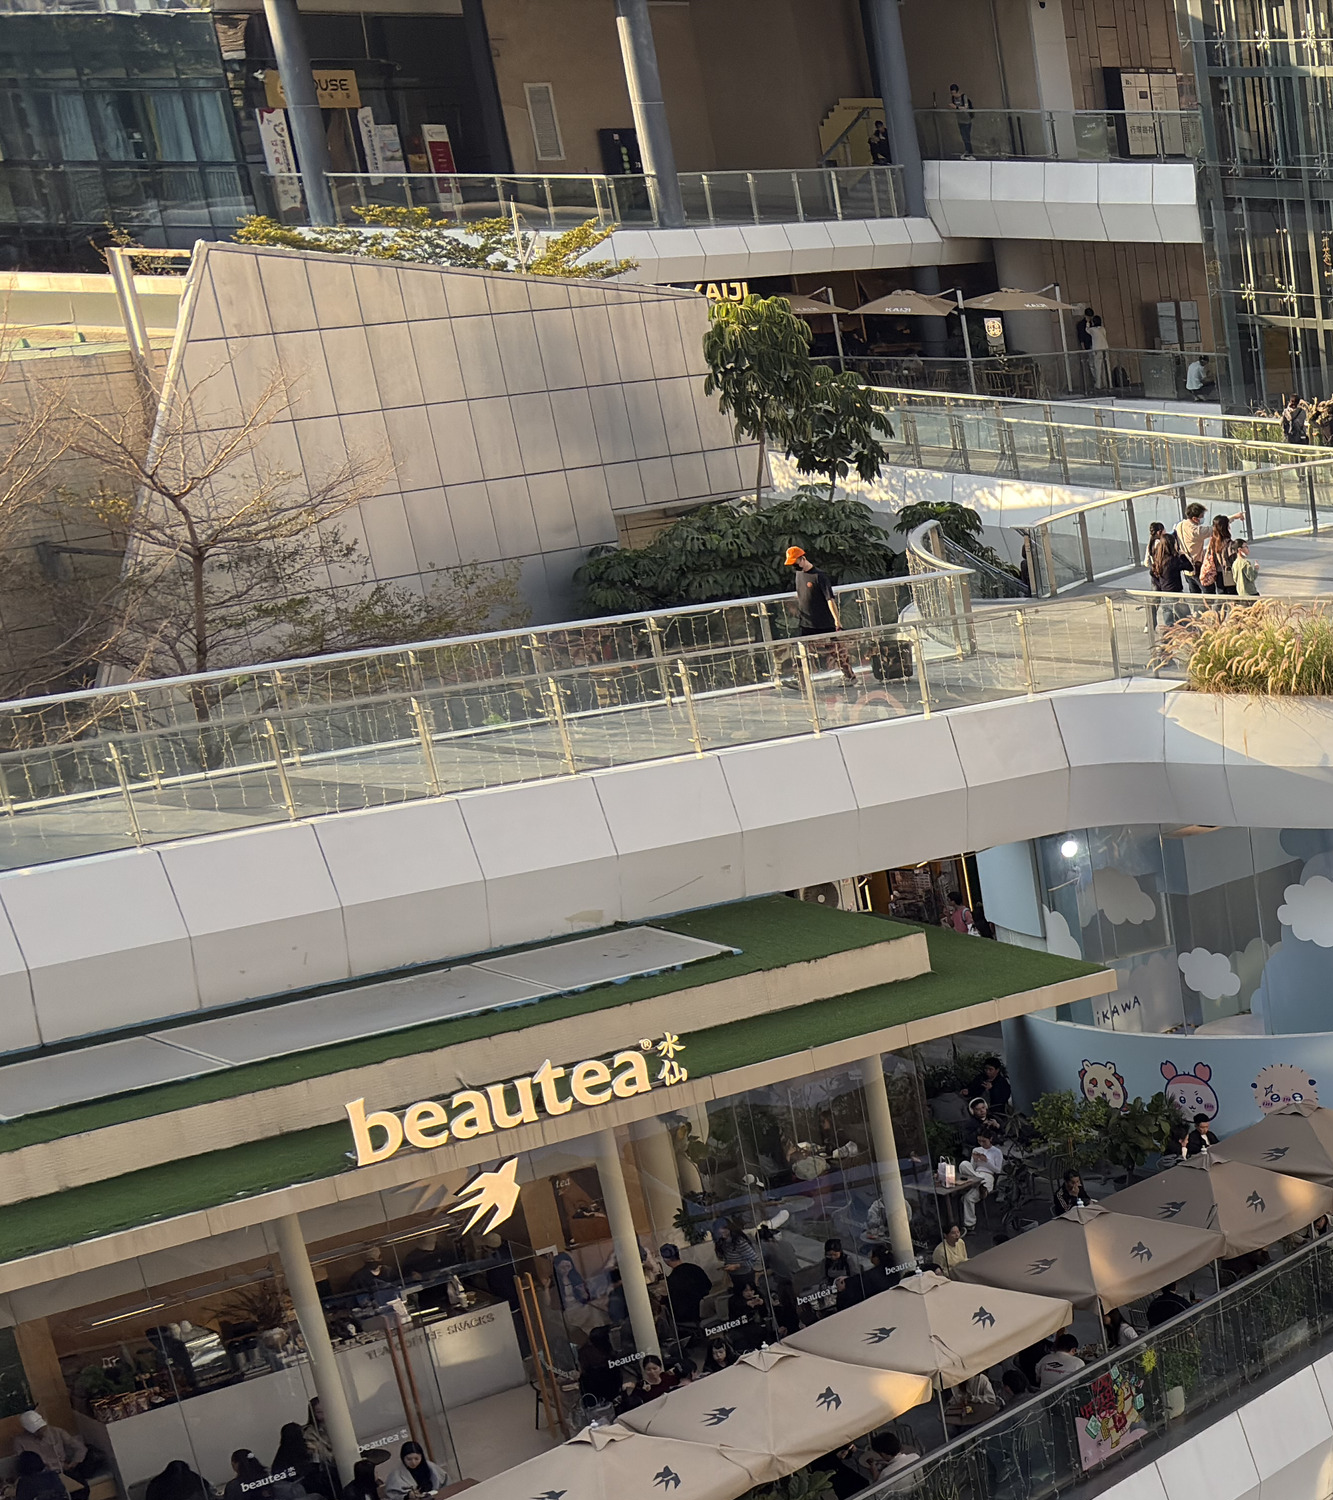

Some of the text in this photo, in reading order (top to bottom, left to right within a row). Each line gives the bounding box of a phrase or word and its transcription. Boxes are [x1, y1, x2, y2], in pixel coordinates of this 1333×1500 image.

[656, 1031, 689, 1087] 水仙
[446, 1312, 496, 1337] SNACKS
[704, 1318, 742, 1337] beautea
[608, 1351, 646, 1369] beautea
[357, 1433, 400, 1454] beautea
[240, 1471, 286, 1493] beautea
